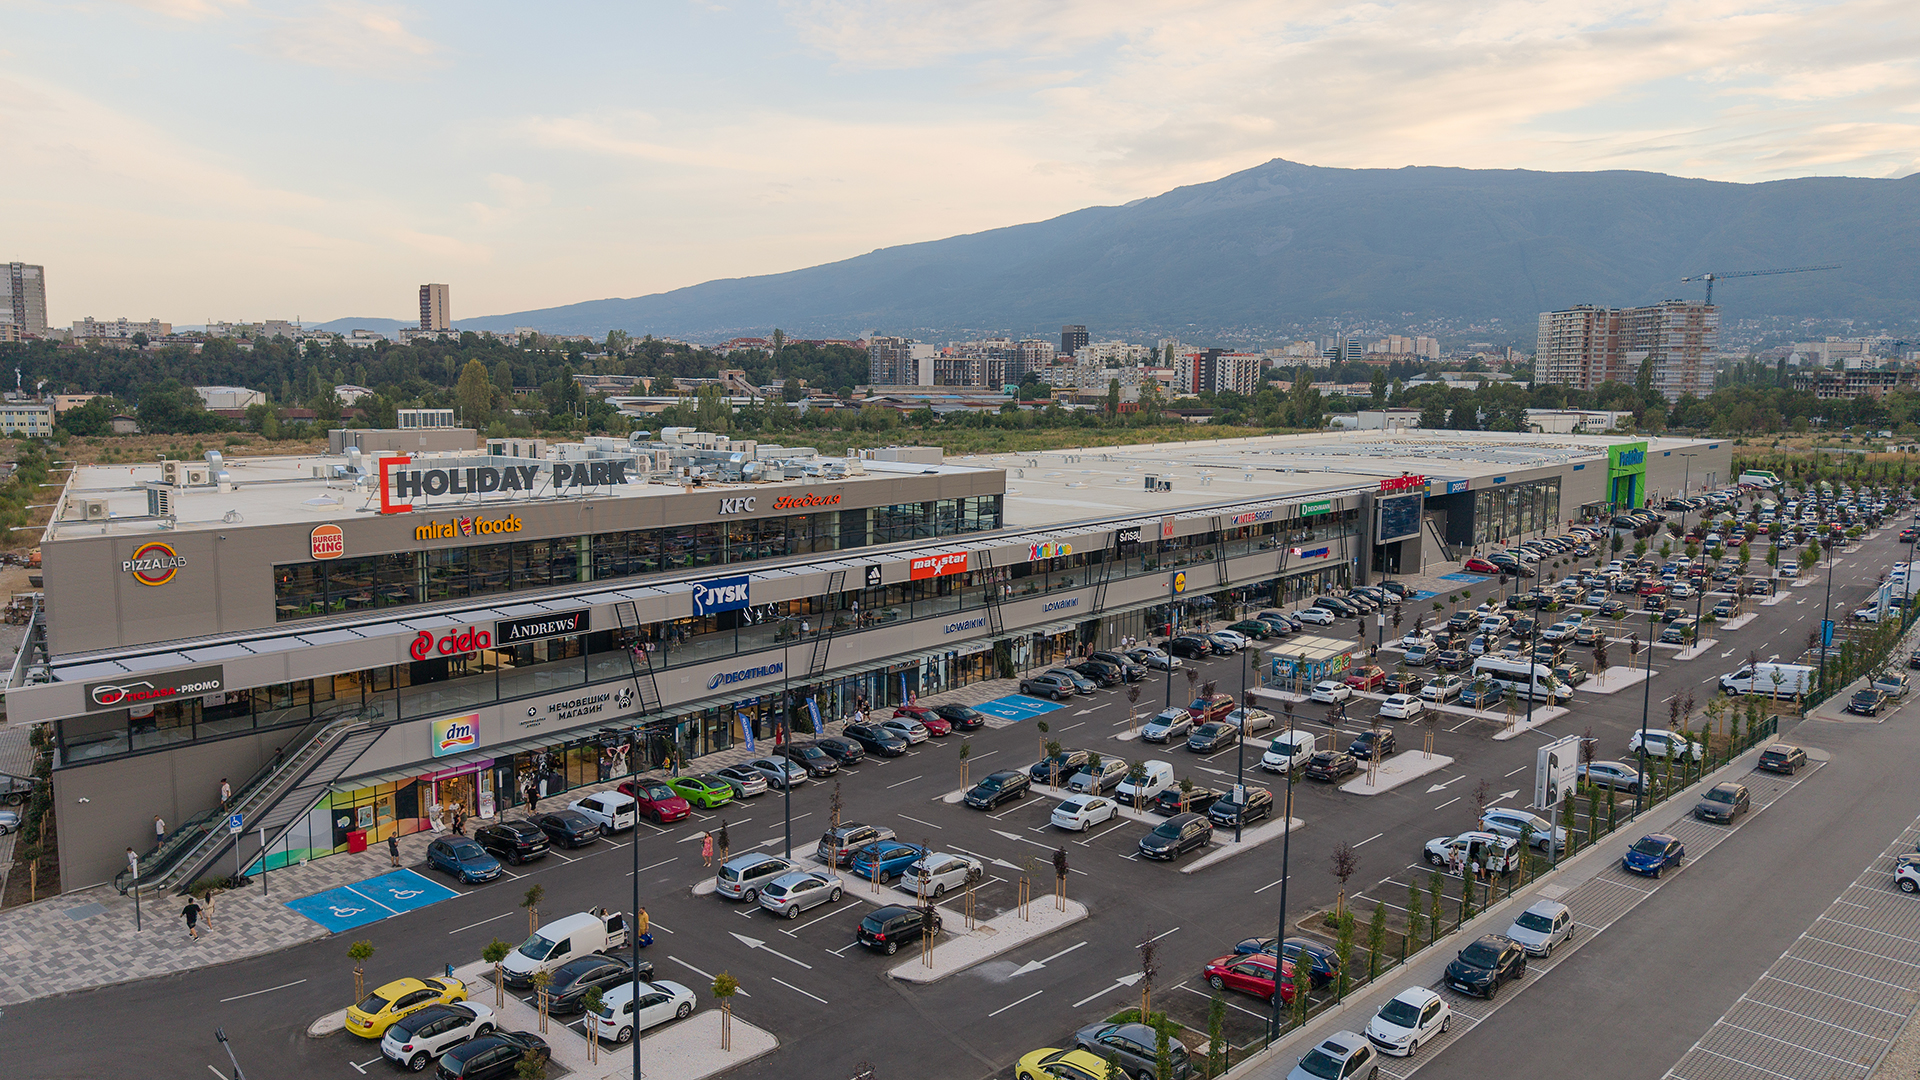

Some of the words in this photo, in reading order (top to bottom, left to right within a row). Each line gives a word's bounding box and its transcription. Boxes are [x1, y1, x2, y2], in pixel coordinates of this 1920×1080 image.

[397, 465, 539, 498] HOLIDAY
[553, 461, 628, 488] PARK
[720, 496, 756, 515] KFC
[773, 493, 841, 510] Неделя
[1238, 510, 1273, 524] INTERSPORT
[415, 518, 458, 541] miral
[474, 513, 523, 535] foods
[1163, 521, 1174, 536] kik
[312, 534, 343, 544] BURGER
[313, 543, 343, 553] KING
[705, 583, 748, 606] JYSK
[438, 626, 491, 655] ciela
[725, 662, 783, 684] DECATHLON
[548, 693, 610, 712] НЕЧОВЕШКИ
[558, 704, 603, 720] МАГАЗИН
[446, 723, 470, 740] dm
